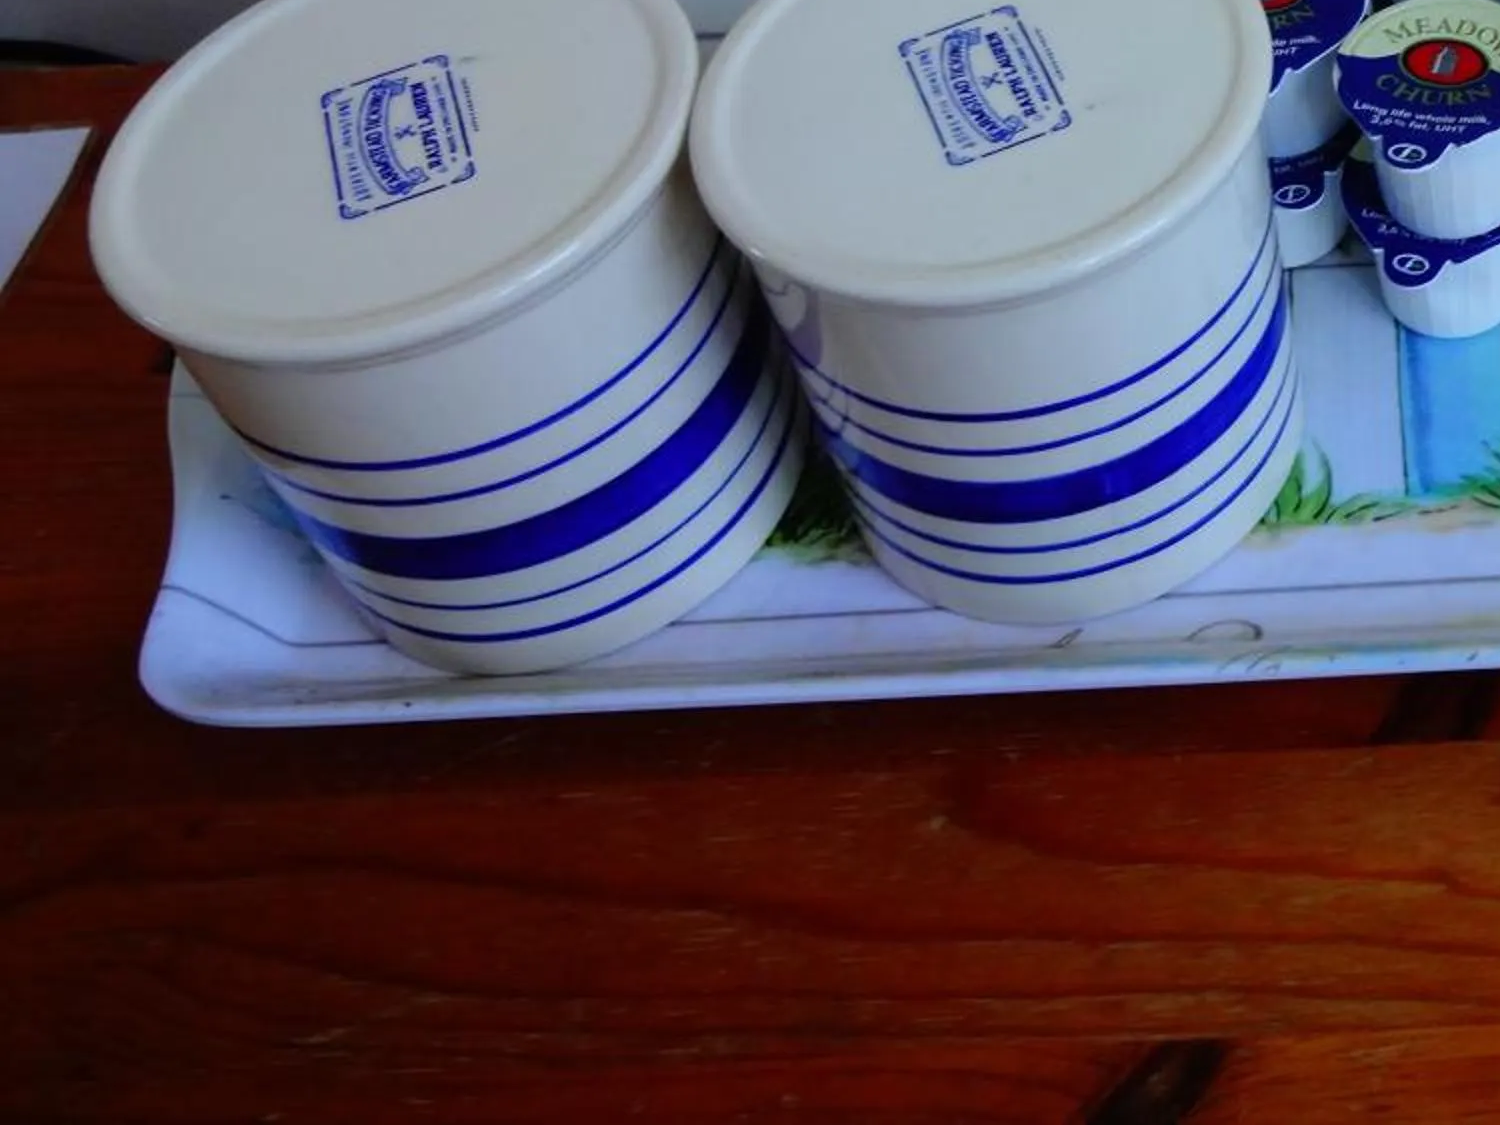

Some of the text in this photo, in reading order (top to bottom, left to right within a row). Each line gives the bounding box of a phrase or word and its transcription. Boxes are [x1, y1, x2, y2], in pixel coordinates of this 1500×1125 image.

[984, 31, 1018, 84] LAUREN
[1006, 77, 1038, 118] RALPH
[1376, 74, 1492, 106] CHURN
[410, 82, 443, 170] RALPH LAUREN
